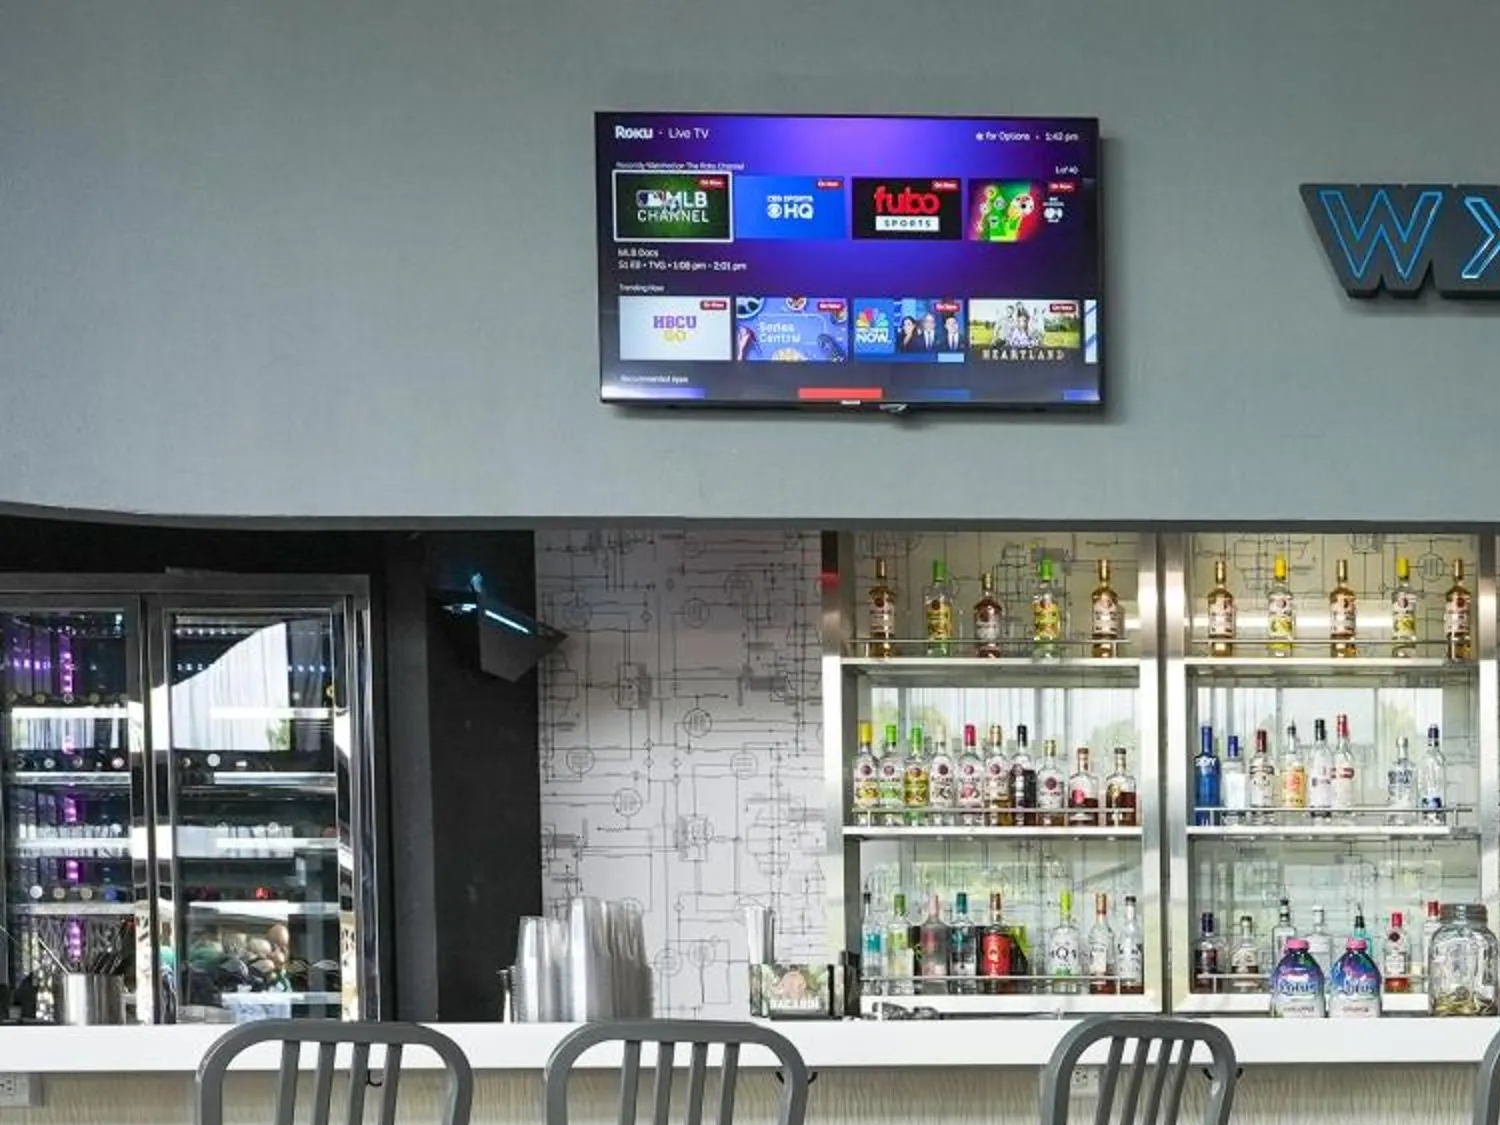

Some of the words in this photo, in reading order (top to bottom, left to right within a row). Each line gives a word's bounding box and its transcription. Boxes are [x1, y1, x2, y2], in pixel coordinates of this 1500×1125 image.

[668, 127, 691, 139] Live
[694, 127, 709, 139] TV
[667, 190, 708, 208] MLB
[874, 184, 940, 214] fubo
[636, 208, 710, 223] CHANNEL
[783, 204, 815, 220] HQ
[883, 218, 932, 229] SPORTS
[653, 315, 697, 329] HBCU
[758, 321, 795, 334] Series
[981, 349, 1066, 362] HEARTLAND
